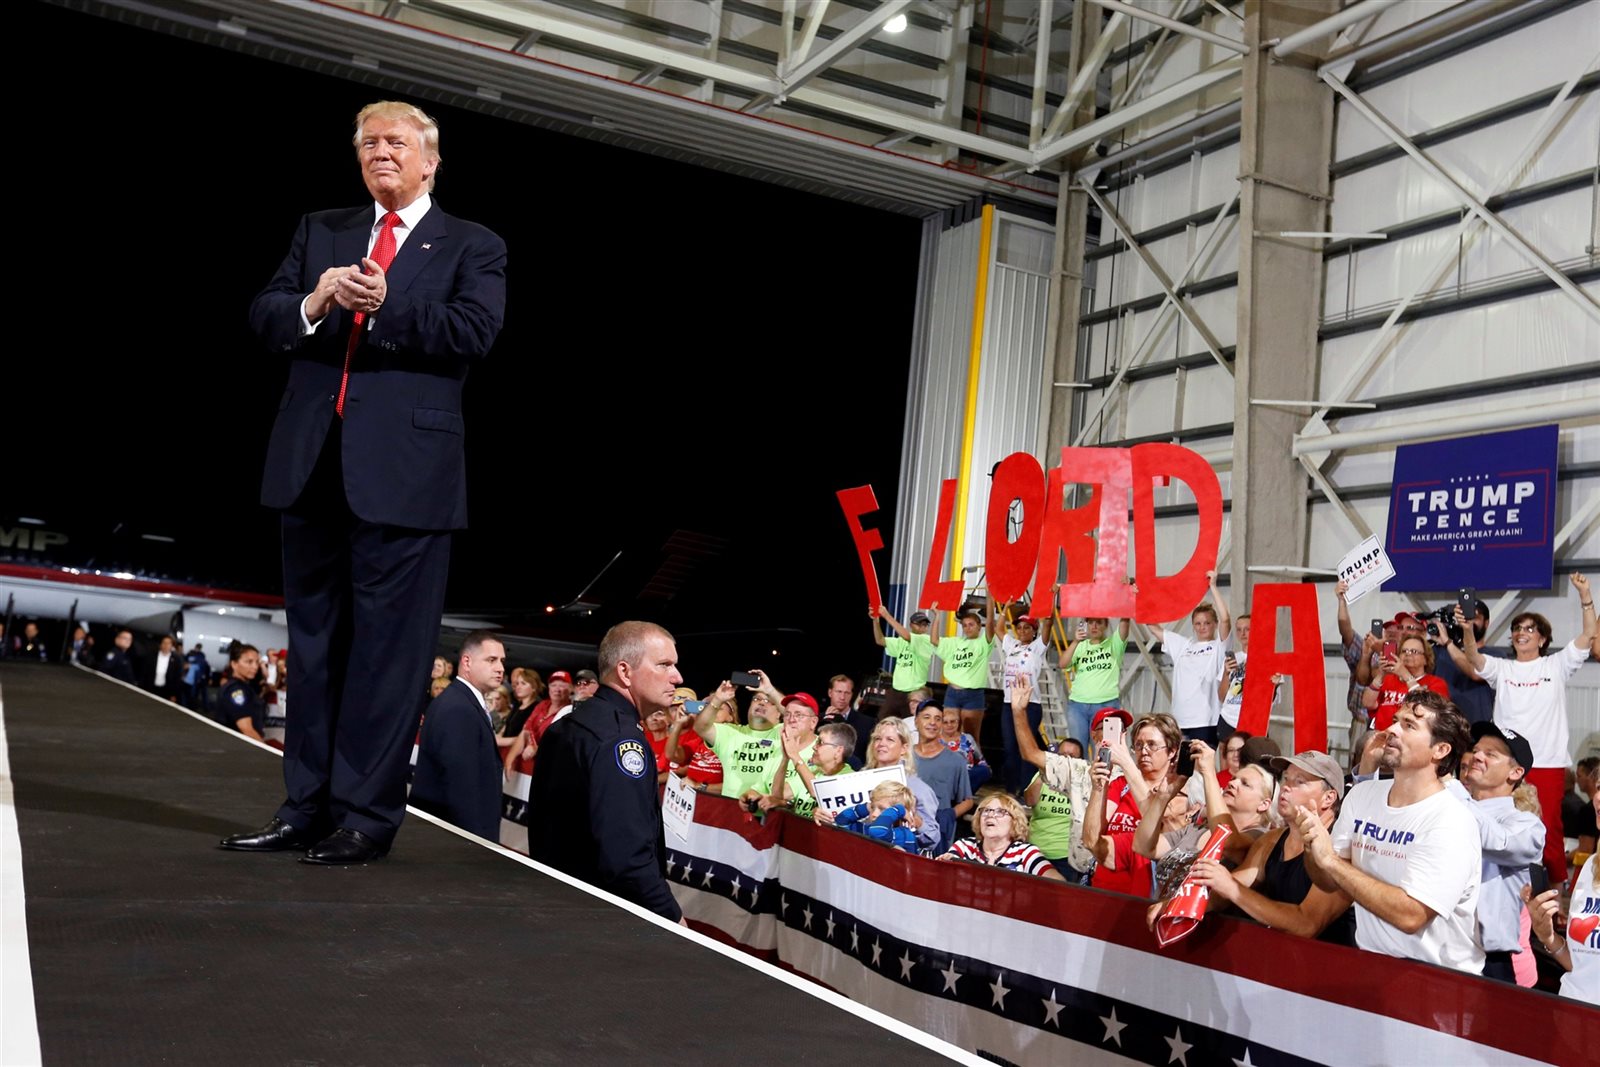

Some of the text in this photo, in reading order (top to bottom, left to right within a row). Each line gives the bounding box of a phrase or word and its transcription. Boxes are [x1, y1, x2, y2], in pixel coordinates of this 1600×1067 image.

[1408, 481, 1535, 513] TRUMP
[1415, 508, 1520, 530] PENCE
[1411, 527, 1523, 542] MAKE AMERICA GREAT AGAIN!
[1452, 543, 1476, 552] 2016
[1340, 548, 1380, 579] TRUMP
[1345, 558, 1380, 584] PENCE
[1076, 652, 1112, 664] TRUMP
[618, 741, 645, 758] POLICE
[667, 786, 692, 812] TRUMP
[822, 790, 872, 809] TRU
[1353, 819, 1415, 846] TRUMP
